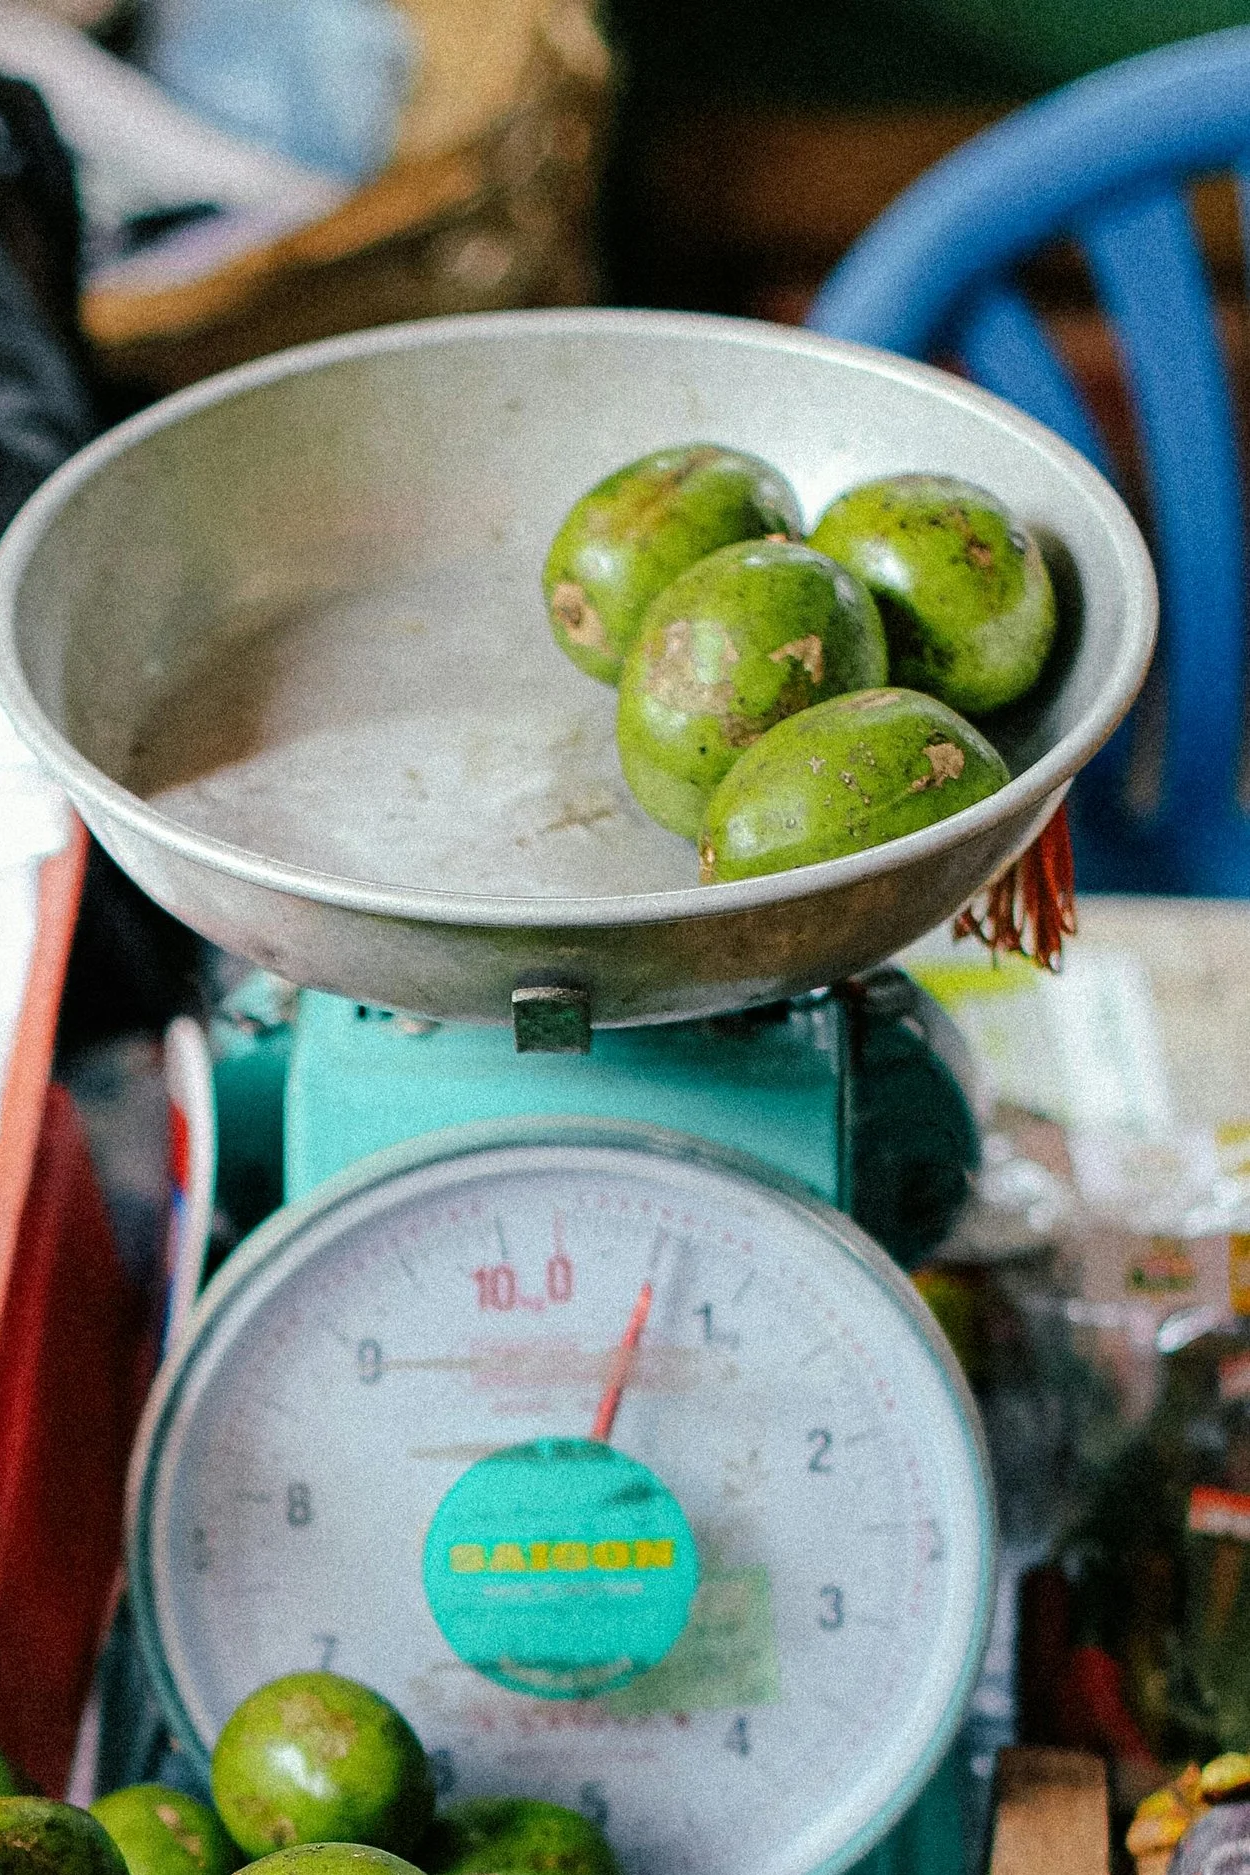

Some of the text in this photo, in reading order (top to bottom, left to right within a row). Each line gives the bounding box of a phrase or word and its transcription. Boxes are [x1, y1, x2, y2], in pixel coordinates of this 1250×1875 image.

[356, 1336, 385, 1386] 9
[809, 1430, 835, 1474] 2
[284, 1481, 313, 1528] 8
[449, 1539, 675, 1574] SAIGON
[819, 1585, 846, 1631] 3
[312, 1630, 341, 1672] 7
[723, 1715, 753, 1757] 4
